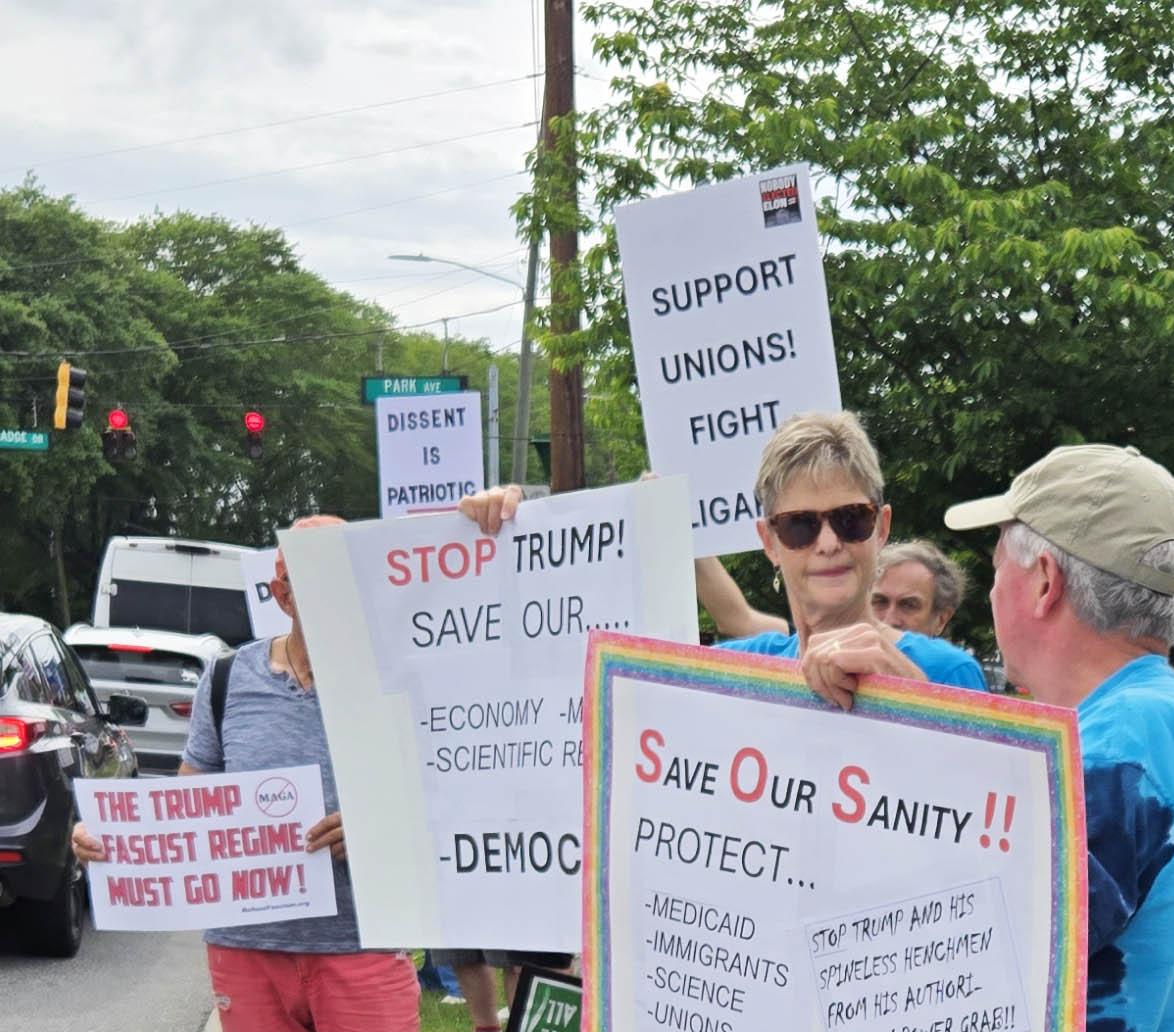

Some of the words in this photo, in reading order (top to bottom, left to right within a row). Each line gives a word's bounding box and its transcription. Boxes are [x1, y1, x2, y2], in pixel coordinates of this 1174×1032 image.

[652, 254, 797, 316] SUPPORT
[660, 329, 796, 384] UNIONS!
[384, 379, 417, 393] PARK
[423, 382, 442, 393] AVE
[387, 407, 466, 433] DISSENT
[689, 400, 780, 445] FIGHT
[423, 446, 441, 465] IS
[387, 481, 476, 505] PATRIOTIC
[386, 538, 498, 587] STOP
[513, 519, 625, 573] TRUMP!
[412, 603, 502, 648] SAVE
[420, 697, 544, 733] -ECONOMY
[426, 740, 553, 772] -SCIENTIFIC
[94, 791, 141, 822] THE
[149, 785, 241, 821] TRUMP
[258, 793, 294, 803] MAGA
[101, 831, 198, 865] FASCIST
[208, 822, 305, 860] REGIME
[439, 831, 582, 876] -DEMOC
[634, 817, 815, 890] PROTECT...
[107, 876, 173, 907] MUST
[184, 873, 221, 905] GO
[231, 864, 307, 900] NOW!
[645, 893, 756, 941] -MEDICAID
[811, 922, 847, 953] STOP
[852, 908, 904, 943] TRUMP
[909, 900, 943, 932] AND
[949, 893, 975, 920] HIS
[646, 930, 789, 988] -IMMIGRANTS
[819, 952, 898, 991] SPINELESS
[903, 927, 993, 974] HENCHMEN
[647, 965, 746, 1013] -SCIENCE
[827, 996, 867, 1029] FROM
[874, 991, 898, 1017] HIS
[904, 971, 984, 1013] AUTHORI-
[546, 999, 578, 1028] ALL
